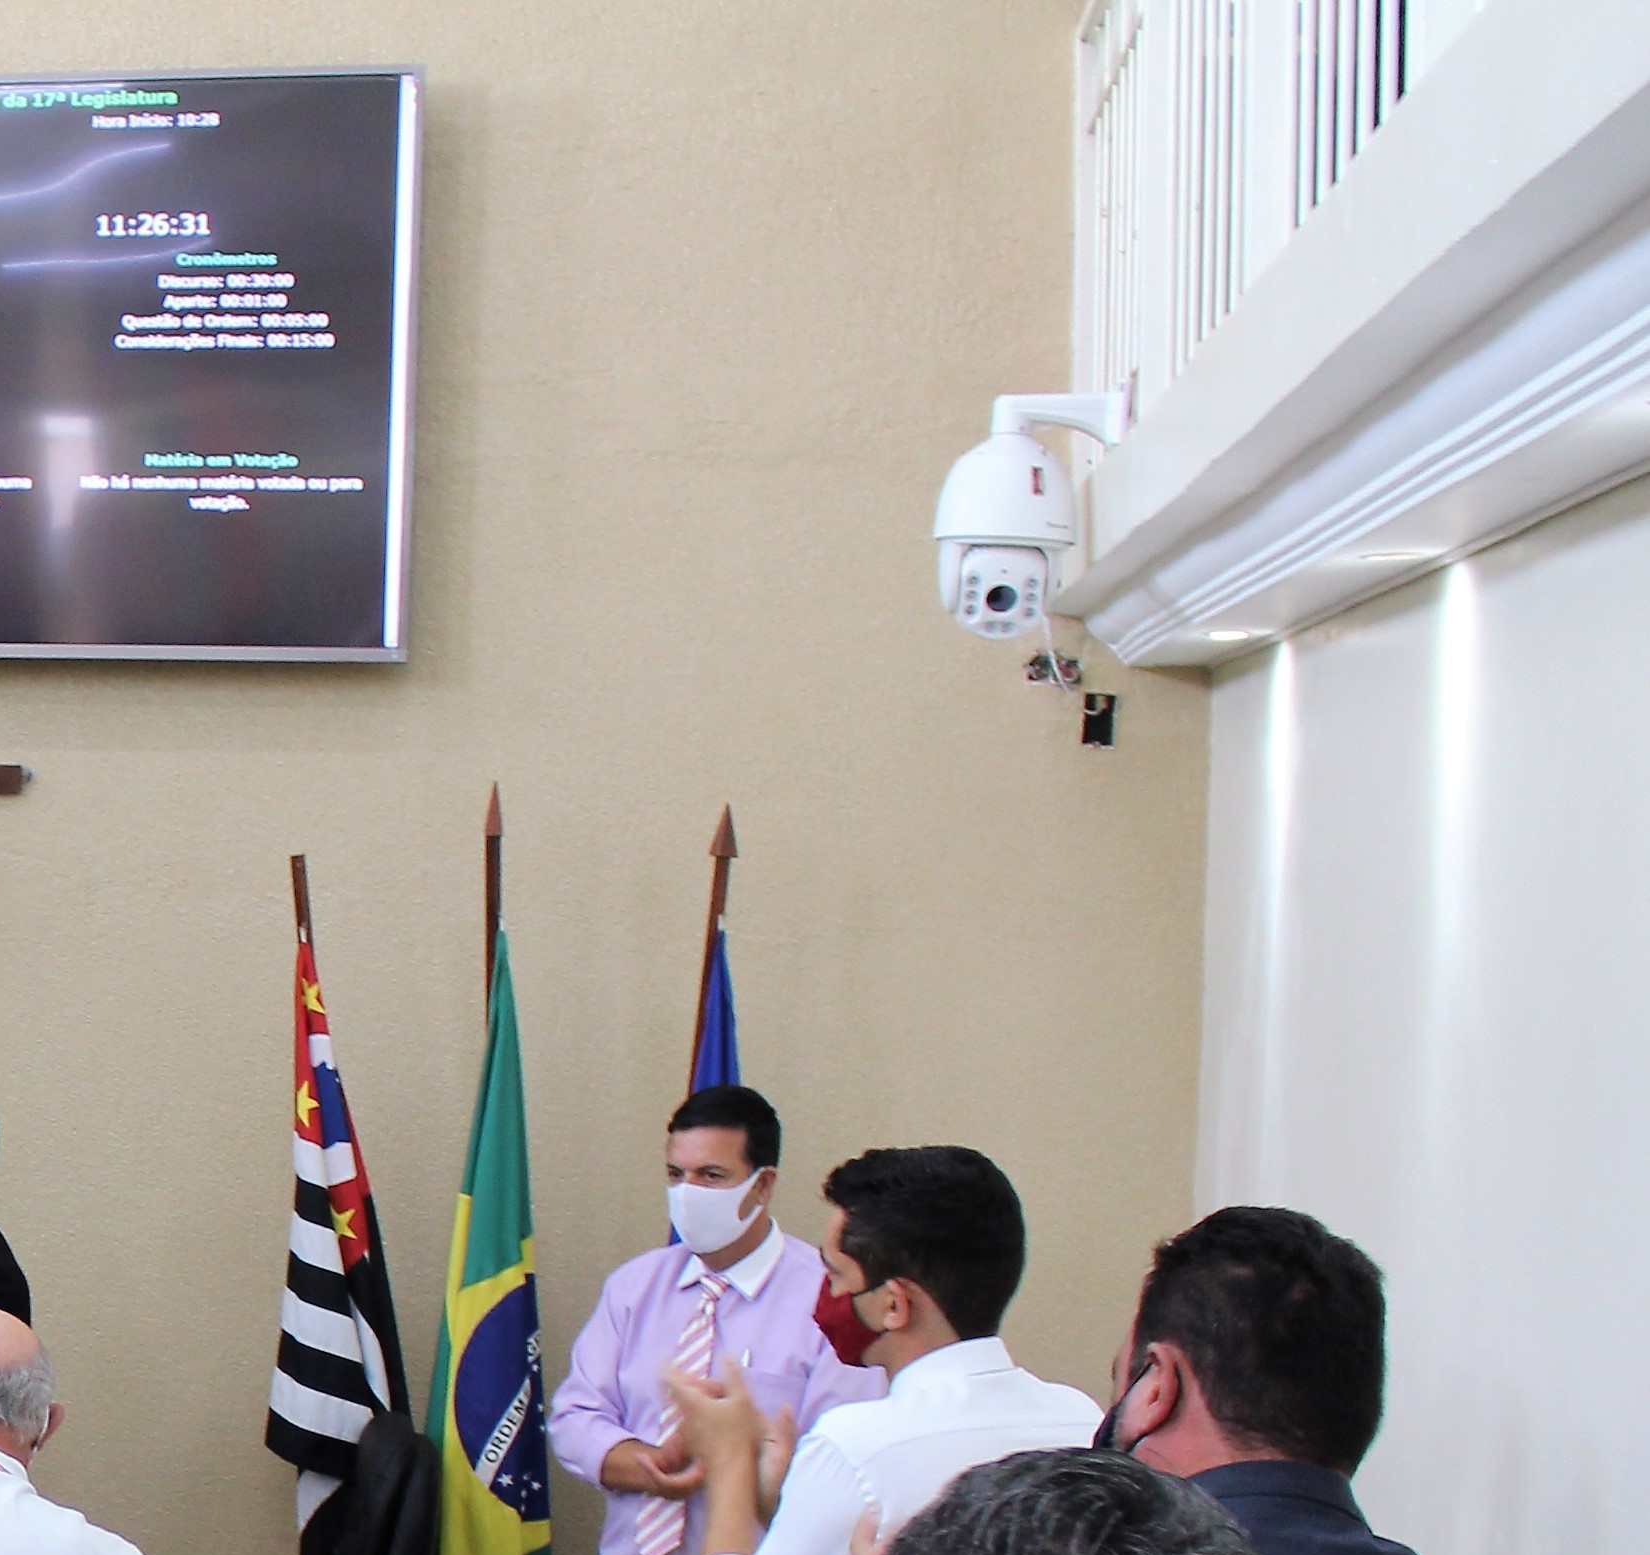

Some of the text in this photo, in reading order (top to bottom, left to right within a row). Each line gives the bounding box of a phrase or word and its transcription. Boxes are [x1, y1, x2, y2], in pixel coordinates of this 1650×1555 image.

[4, 93, 27, 108] da
[32, 92, 65, 107] 17ª
[71, 90, 178, 109] Legislatura
[91, 114, 126, 128] Hora
[97, 212, 211, 236] 11:26:31
[176, 251, 277, 266] Cronômetros
[144, 452, 299, 470] Matéria em Votação
